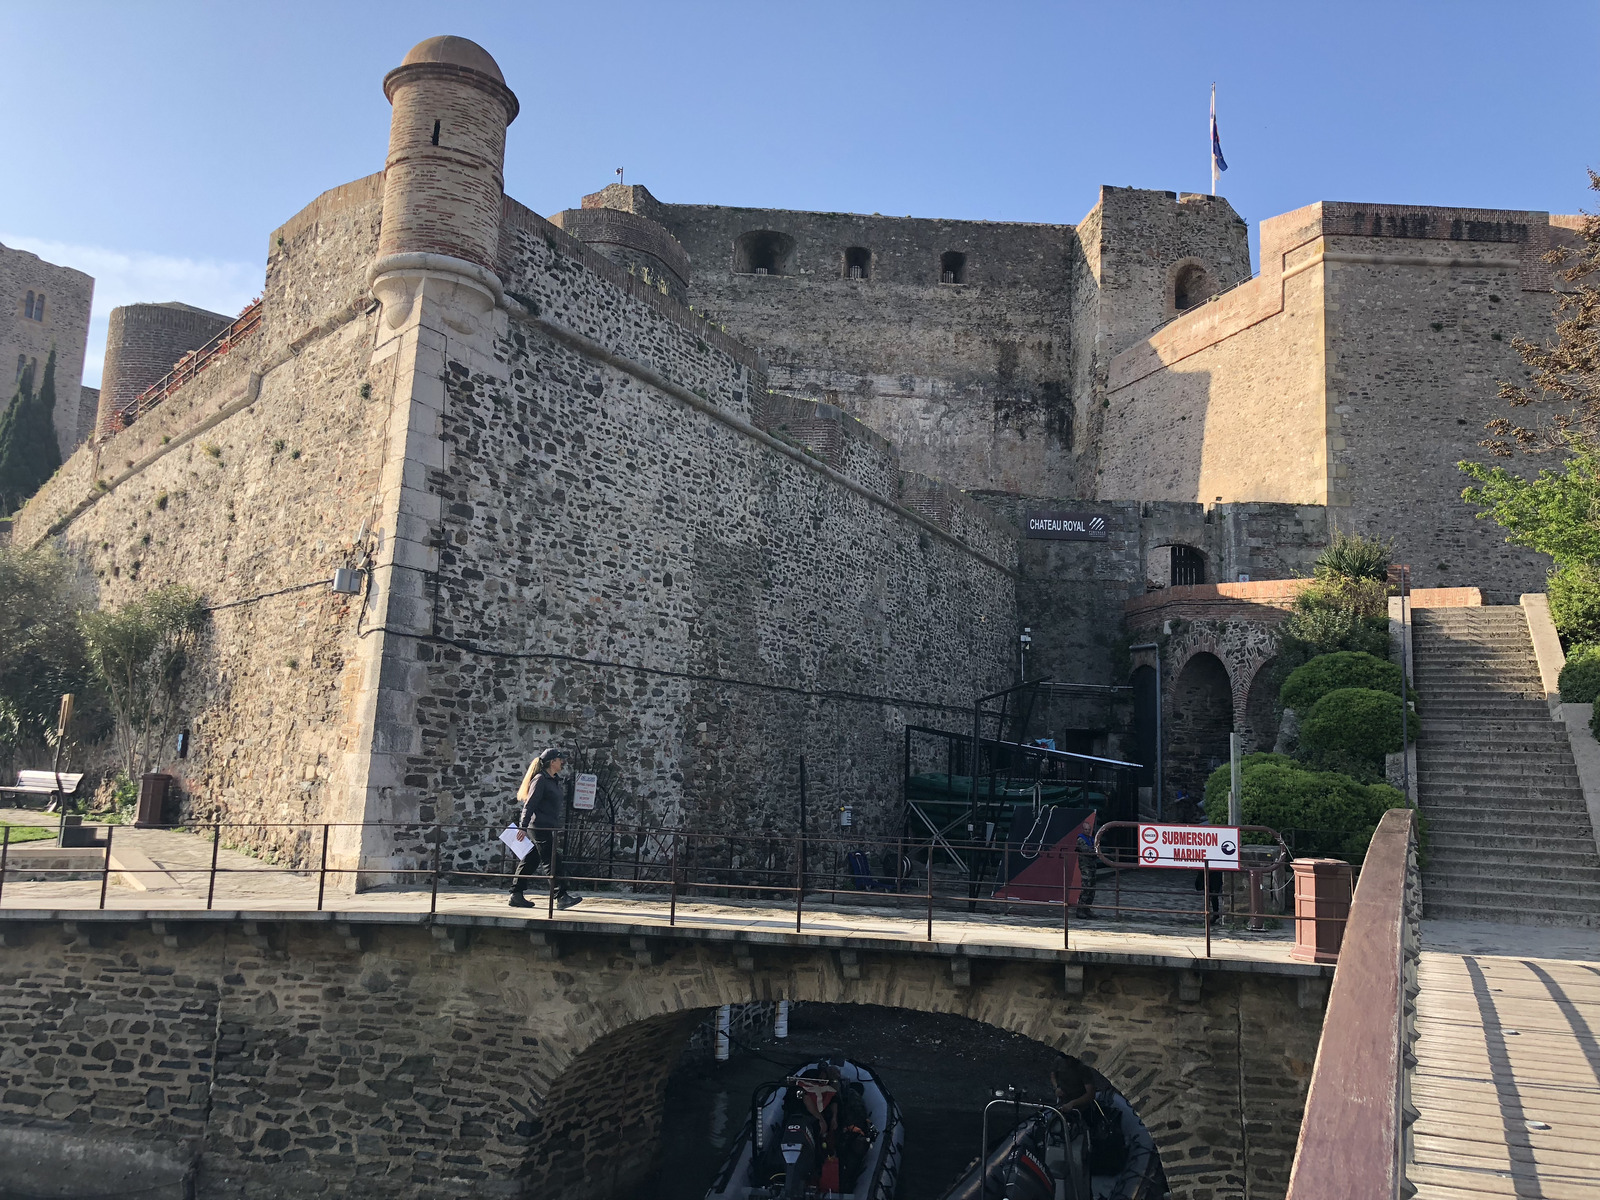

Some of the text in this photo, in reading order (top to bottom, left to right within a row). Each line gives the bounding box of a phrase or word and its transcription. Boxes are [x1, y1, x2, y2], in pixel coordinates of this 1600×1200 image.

[1029, 518, 1086, 532] CHATEAU ROYAL
[1161, 830, 1218, 846] SUBMERSION
[1173, 848, 1207, 863] MARINE
